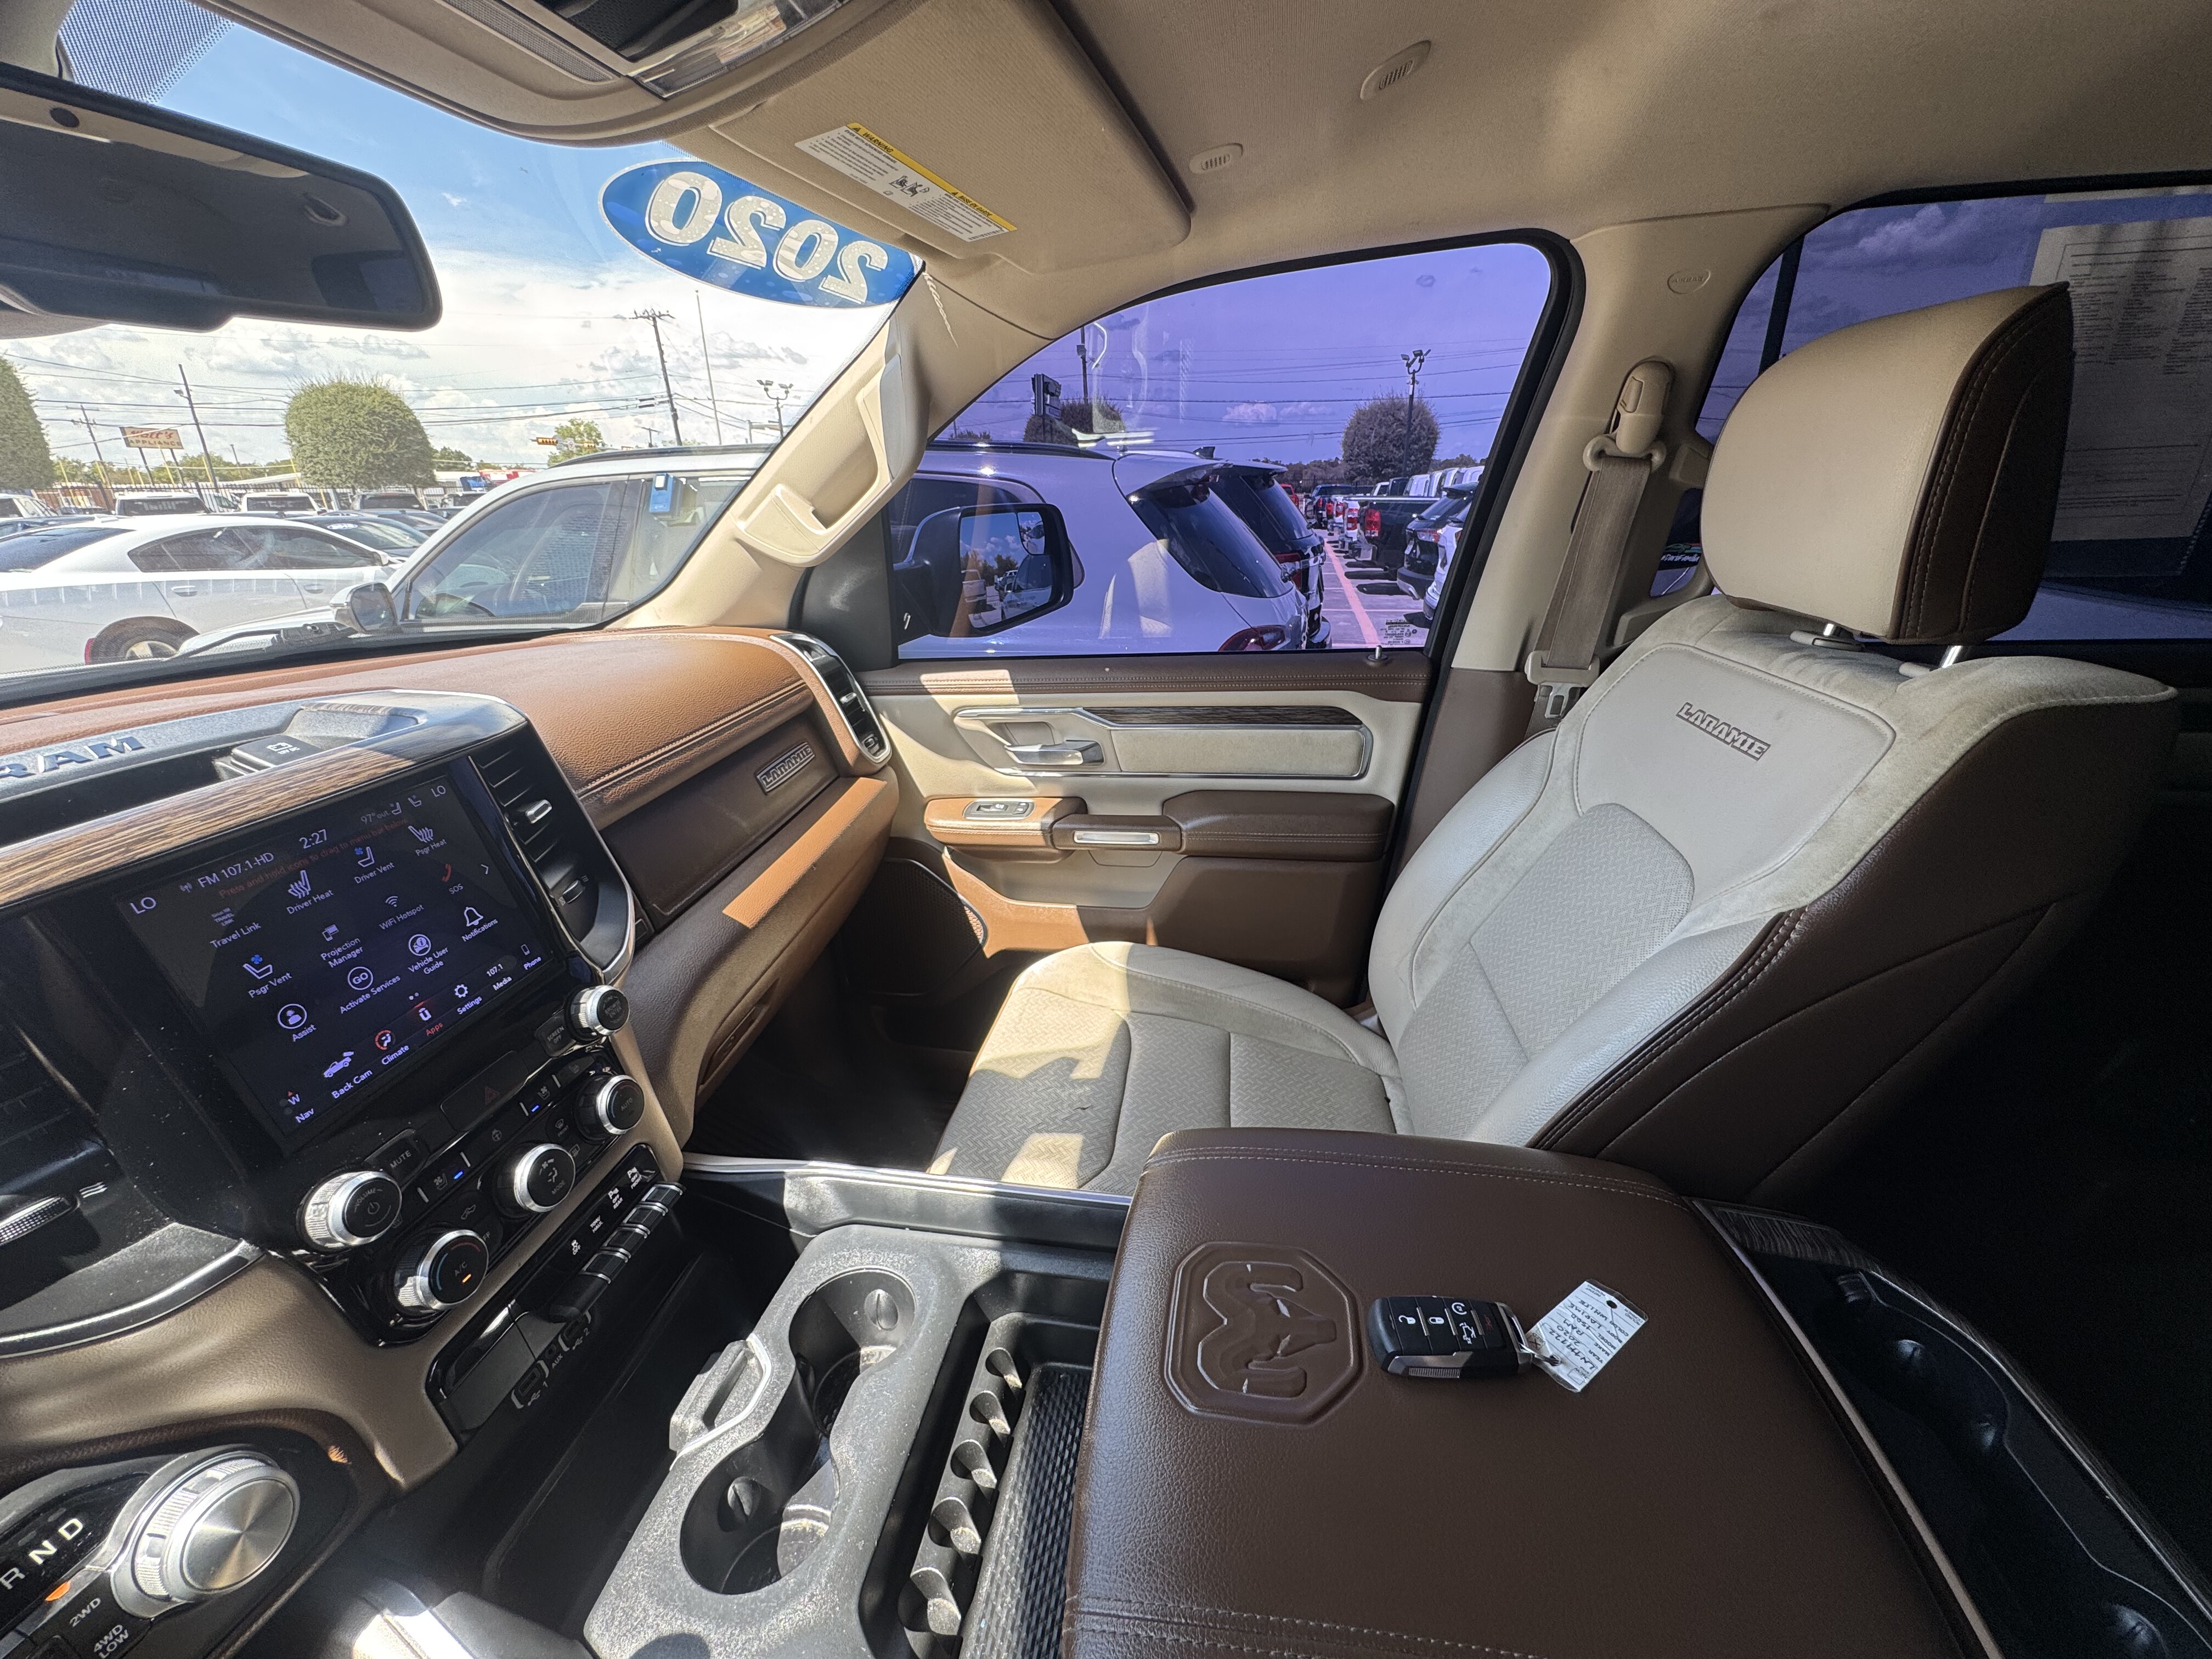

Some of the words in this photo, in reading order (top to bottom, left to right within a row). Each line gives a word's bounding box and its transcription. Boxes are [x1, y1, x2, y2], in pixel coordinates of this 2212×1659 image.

[862, 132, 894, 153] WARNING
[1675, 702, 1771, 762] LARAMIE
[0, 736, 145, 778] RAM
[762, 746, 811, 786] LARAMIE
[431, 785, 446, 798] LO
[298, 828, 327, 849] 2:27
[415, 845, 431, 856] Psgr
[430, 838, 447, 850] Heat
[219, 883, 245, 898] Press
[247, 874, 263, 886] and
[264, 867, 285, 881] hold
[285, 858, 309, 873] icons
[320, 845, 339, 857] drag
[340, 840, 348, 849] to
[349, 832, 371, 845] menu
[371, 827, 386, 836] bar
[386, 818, 408, 831] below
[198, 872, 220, 888] FM
[221, 852, 274, 879] 107.1-HD
[354, 870, 377, 884] Driver
[376, 862, 395, 873] Vent
[448, 883, 464, 894] SOS
[130, 896, 157, 914] LO
[286, 899, 312, 915] Driver
[312, 889, 334, 903] Heat
[379, 917, 397, 930] WiFi
[397, 904, 425, 923] Hotspot
[210, 930, 241, 949] Travel
[240, 922, 262, 935] Link
[461, 918, 499, 942] Notifications
[320, 937, 361, 961] Projection
[328, 946, 364, 968] Manager
[408, 956, 433, 973] Vehicle
[432, 947, 449, 959] User
[423, 960, 444, 975] Guide
[523, 956, 542, 970] Phone
[352, 972, 369, 985] GO
[487, 963, 504, 977] 107.1
[247, 984, 269, 998] Psgr
[268, 972, 293, 987] Vent
[492, 975, 512, 991] Media
[340, 992, 371, 1014] Activate
[370, 975, 401, 996] Services
[456, 996, 482, 1015] Settings
[292, 1024, 317, 1042] Assist
[425, 1022, 444, 1036] Apps
[547, 1025, 565, 1042] SCREEN
[553, 1034, 563, 1043] OFF
[381, 1044, 410, 1065] Climate
[331, 1082, 354, 1099] Back
[353, 1069, 374, 1085] Cam
[287, 1093, 301, 1105] W
[620, 1098, 634, 1111] AUTO
[295, 1108, 315, 1124] Nav
[390, 1149, 411, 1169] MUTE
[356, 1187, 376, 1206] VOLUME
[551, 1180, 566, 1195] MODE
[482, 1231, 491, 1242] FF
[454, 1261, 467, 1277] A/C
[583, 1327, 590, 1337] 2
[1557, 1325, 1581, 1347] 2020
[1563, 1319, 1585, 1336] RAM
[1606, 1329, 1623, 1344] BODY
[1609, 1321, 1629, 1338] COLOR
[1594, 1341, 1611, 1357] MAKE
[1598, 1333, 1616, 1350] MODEL
[551, 1353, 563, 1369] AUX
[1588, 1350, 1603, 1364] YEAR
[58, 1518, 84, 1541] D
[29, 1540, 58, 1565] N
[0, 1567, 26, 1590] R
[69, 1598, 101, 1627] 2WD
[93, 1624, 123, 1652] 4WD
[98, 1629, 129, 1659] LOW
